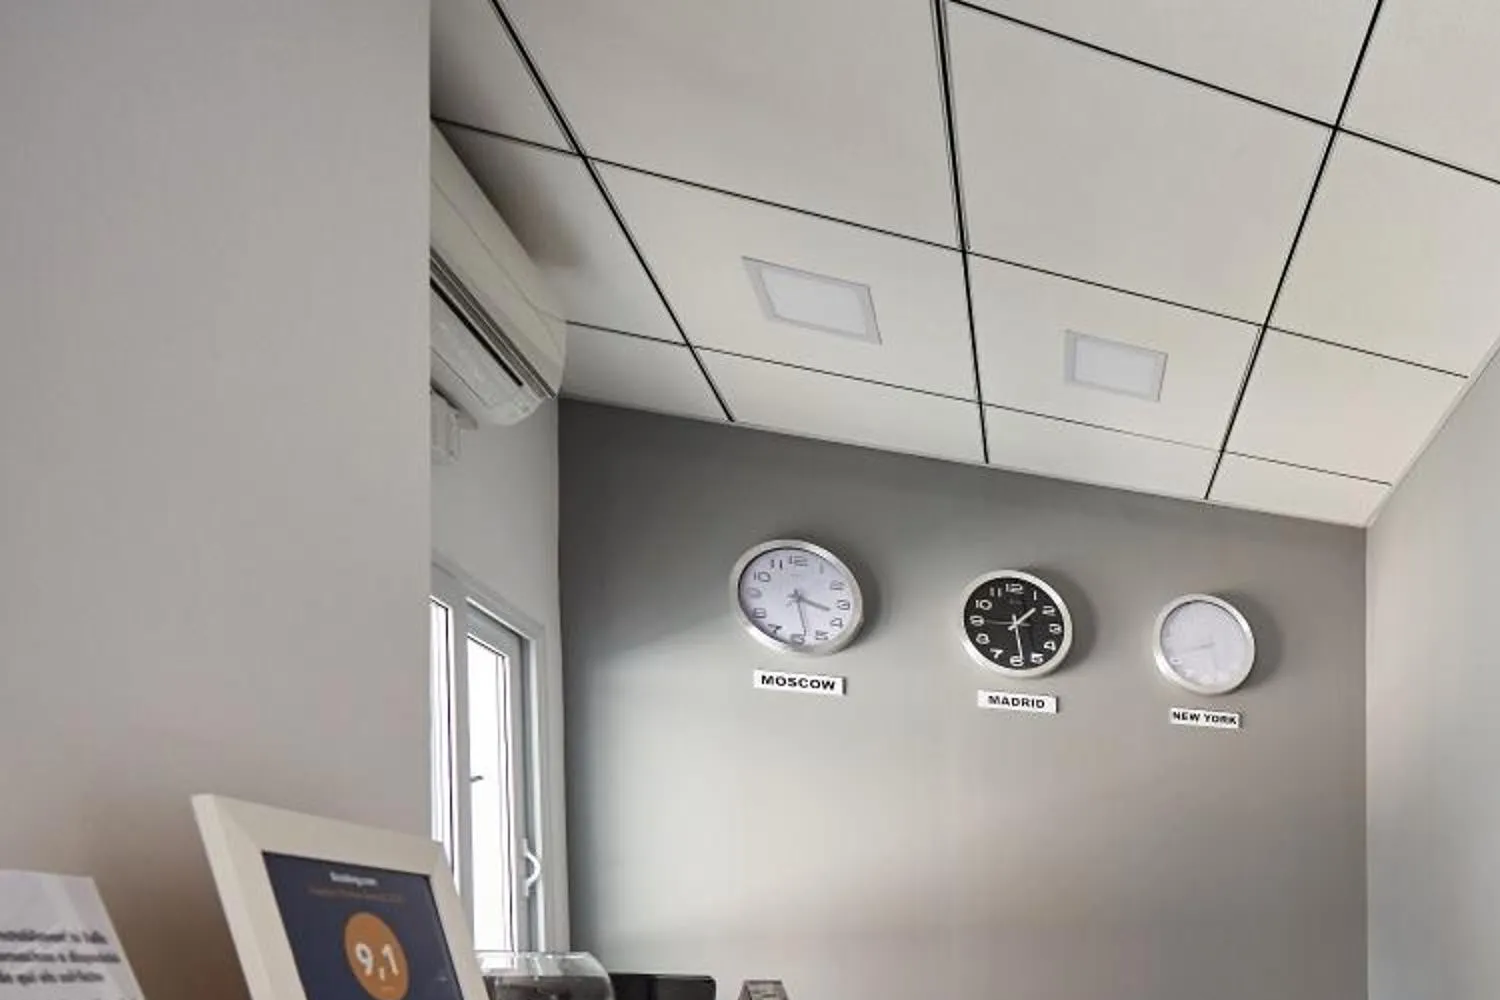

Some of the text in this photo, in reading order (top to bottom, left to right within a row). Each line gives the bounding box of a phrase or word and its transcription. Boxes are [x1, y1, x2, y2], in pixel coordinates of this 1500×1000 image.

[753, 571, 771, 583] 10
[989, 587, 1002, 598] 11
[1005, 583, 1024, 594] 12
[1033, 590, 1038, 601] 1
[975, 599, 993, 611] 10
[1042, 605, 1056, 616] 2
[1049, 623, 1062, 634] 3
[1043, 640, 1056, 651] 4
[990, 648, 1004, 659] 7
[1031, 653, 1044, 664] 5
[761, 675, 836, 691] MOSCOW
[988, 695, 1046, 709] MADRID
[1172, 711, 1237, 725] NEW YORK
[355, 941, 400, 981] 9,1
